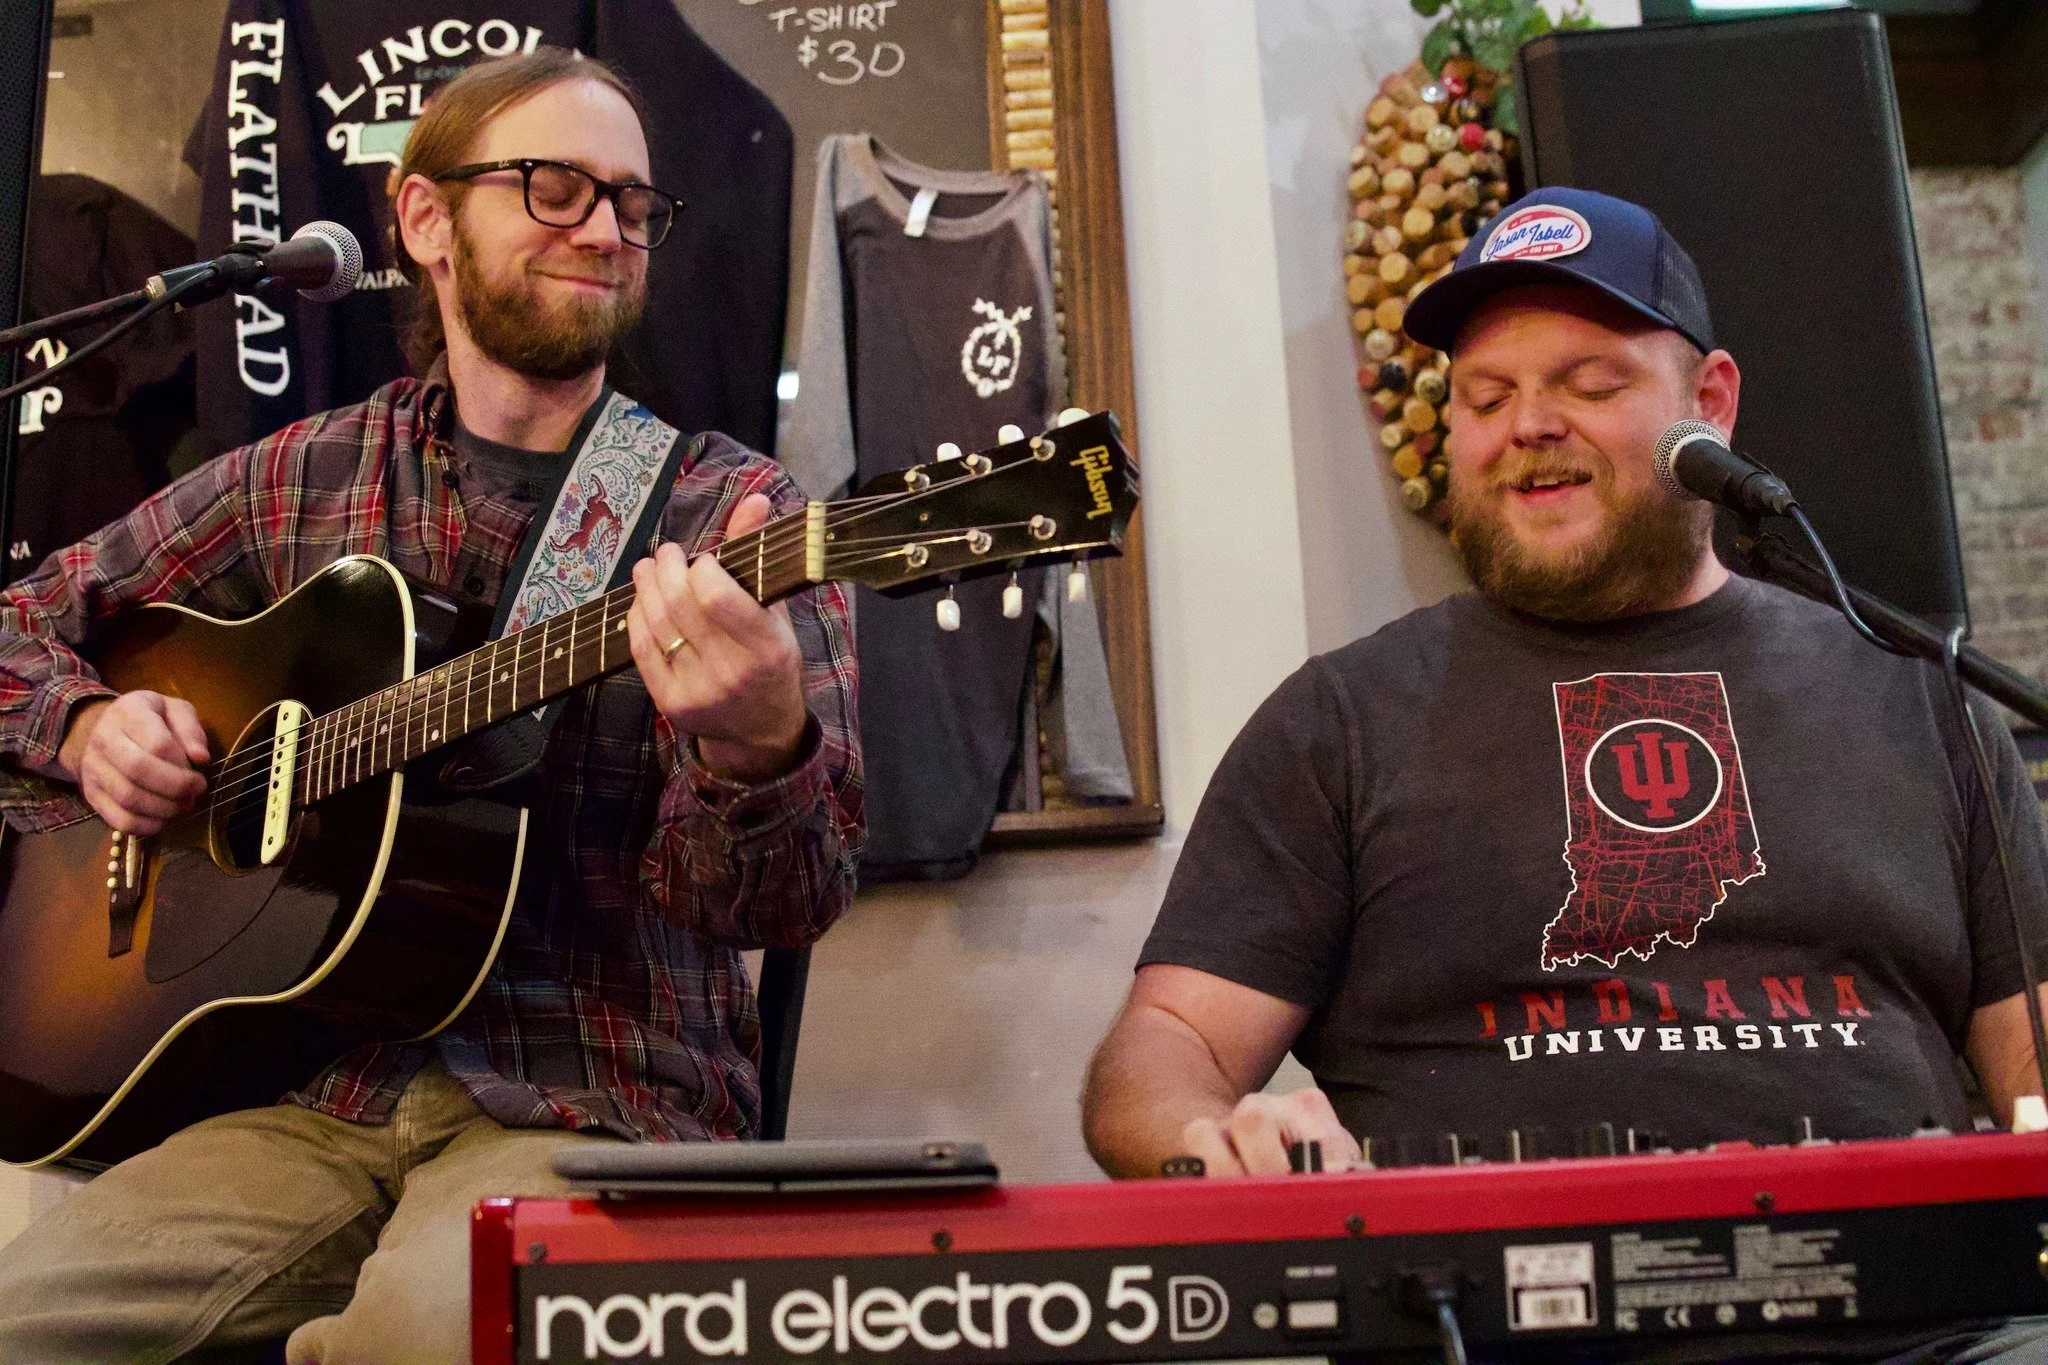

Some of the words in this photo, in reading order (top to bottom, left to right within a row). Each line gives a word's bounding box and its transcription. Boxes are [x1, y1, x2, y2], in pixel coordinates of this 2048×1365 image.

[768, 0, 898, 33] T-SHIRT
[797, 35, 906, 85] $30
[228, 18, 290, 397] FLATHAD
[1486, 227, 1527, 262] Jason
[1529, 223, 1575, 245] Isbell
[1070, 445, 1113, 520] Gibson
[1477, 973, 1873, 1039] INDIANA
[1504, 1022, 1859, 1061] UNIVERSITY
[535, 1278, 748, 1360] nord
[771, 1271, 1092, 1354] electro
